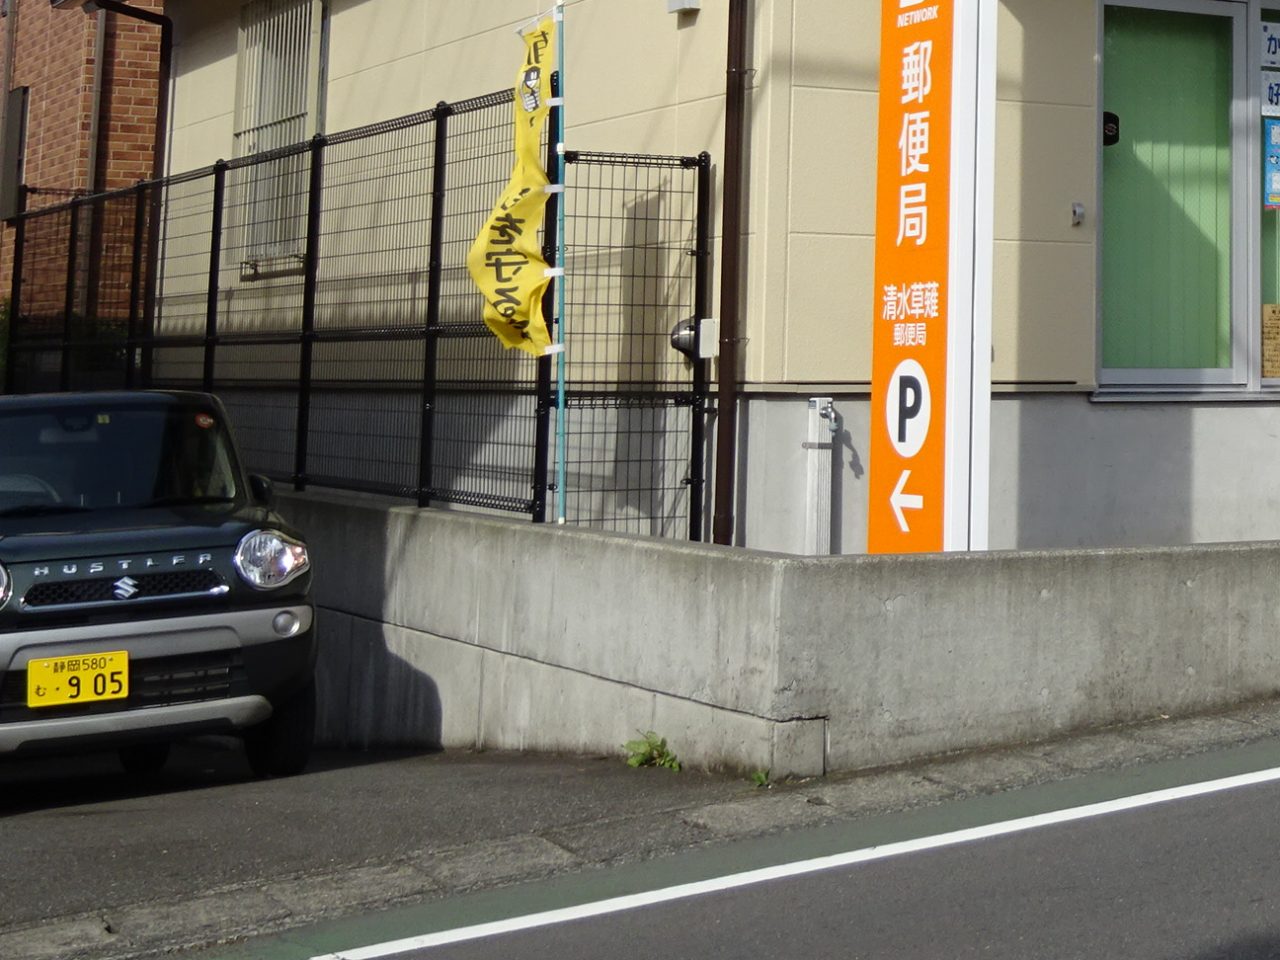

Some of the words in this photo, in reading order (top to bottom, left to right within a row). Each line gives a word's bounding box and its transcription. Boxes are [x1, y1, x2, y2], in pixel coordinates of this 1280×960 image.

[897, 5, 940, 28] NETWORK
[896, 40, 933, 248] 郵便局
[882, 280, 940, 321] 清水草薙
[893, 322, 927, 347] 郵便局
[897, 374, 923, 443] P
[34, 553, 213, 576] HUSTLER
